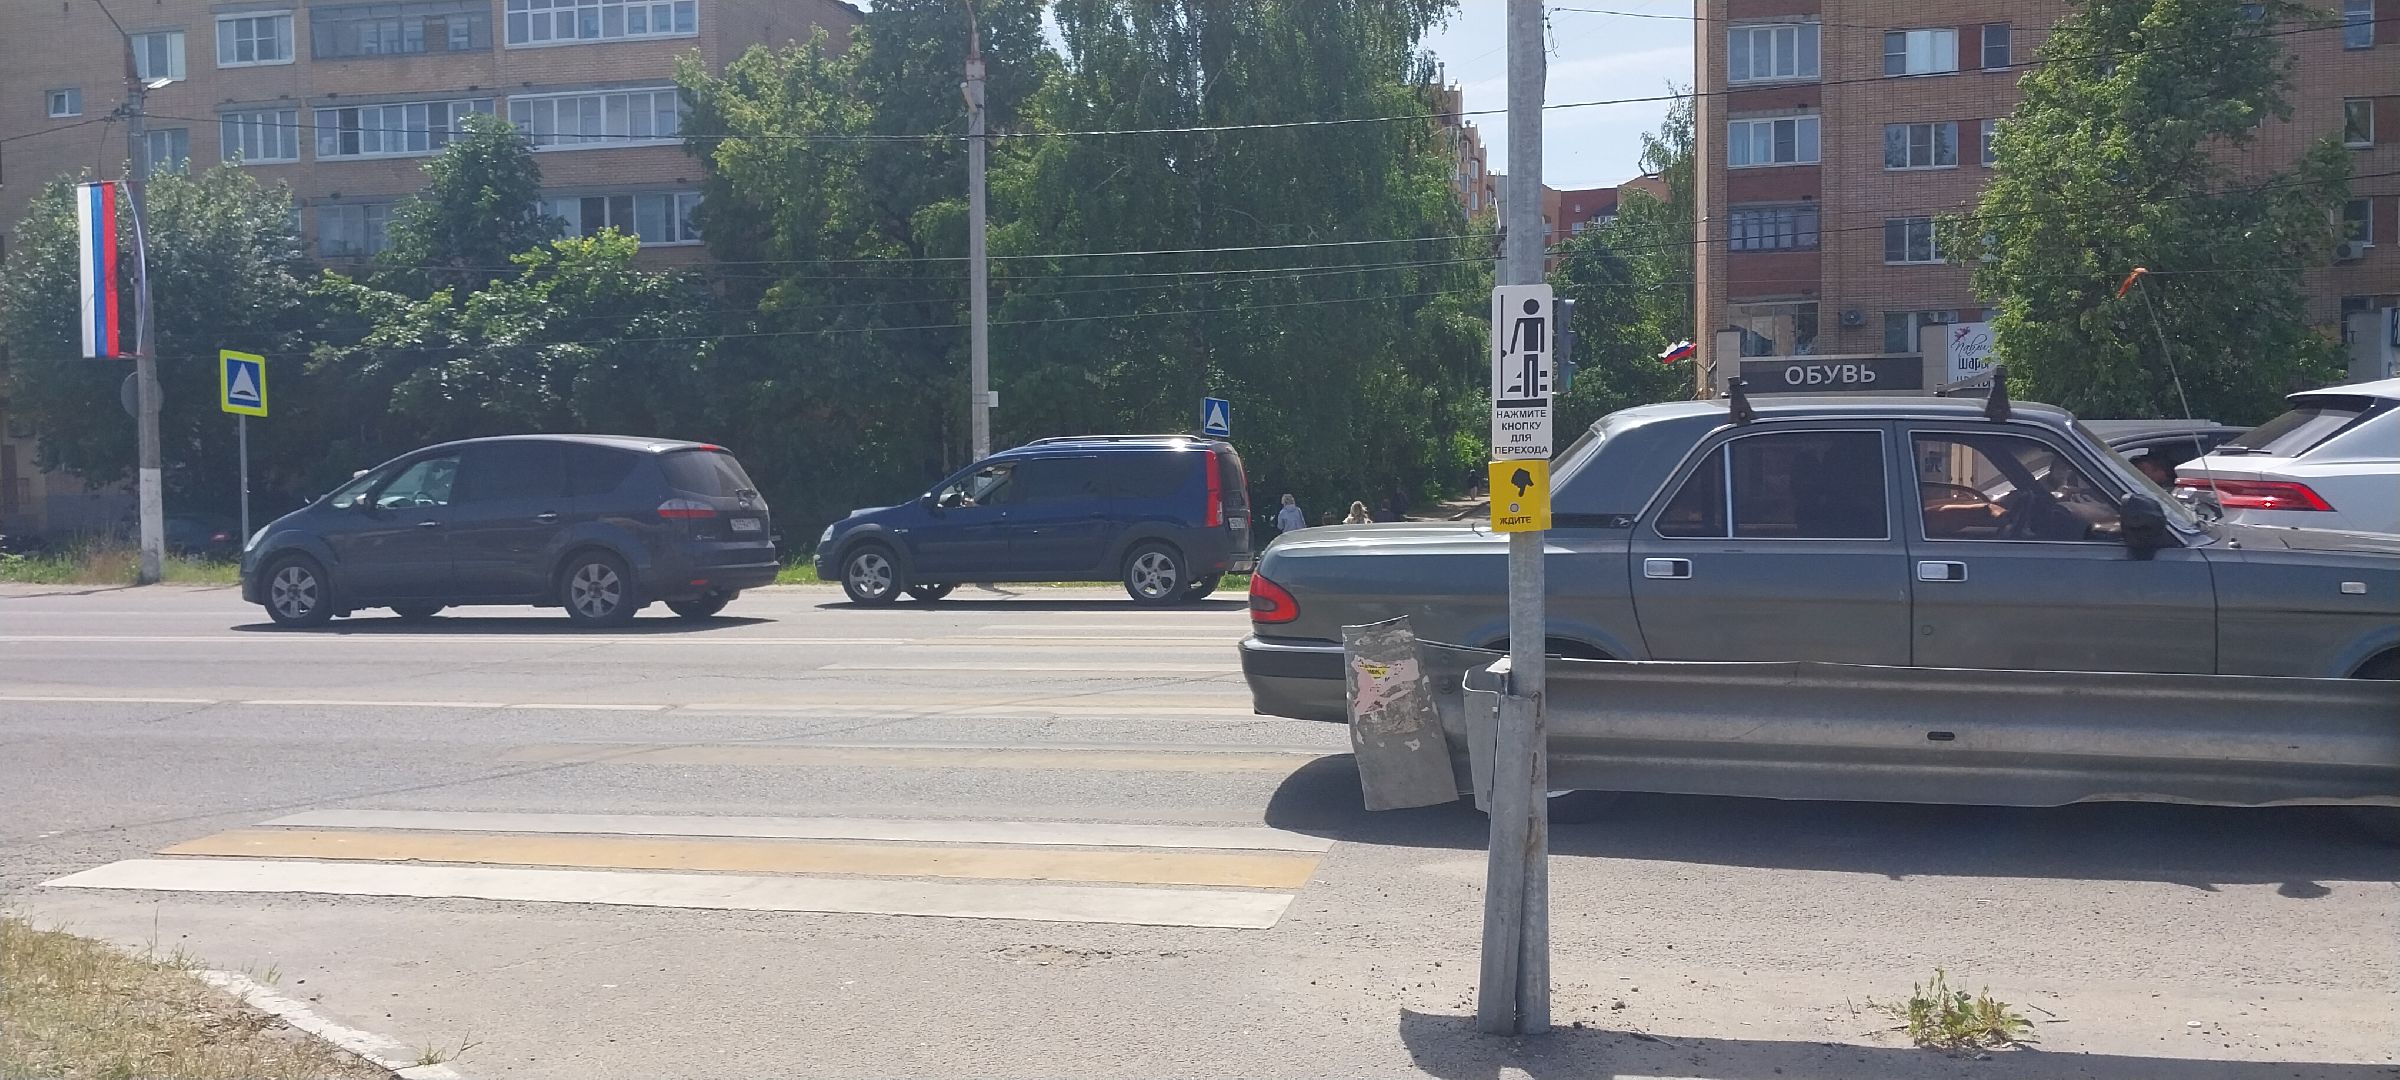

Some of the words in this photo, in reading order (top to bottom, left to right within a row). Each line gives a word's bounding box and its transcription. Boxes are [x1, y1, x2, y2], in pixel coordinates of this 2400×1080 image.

[1784, 364, 1876, 385] ОБУВЬ
[1496, 409, 1547, 419] НАЖМИТЕ
[1502, 422, 1541, 431] КНОПКУ
[1511, 434, 1532, 443] ДЛЯ
[1494, 446, 1548, 455] ПЕРЕХОДА
[1499, 516, 1532, 526] ЖДИТЕ
